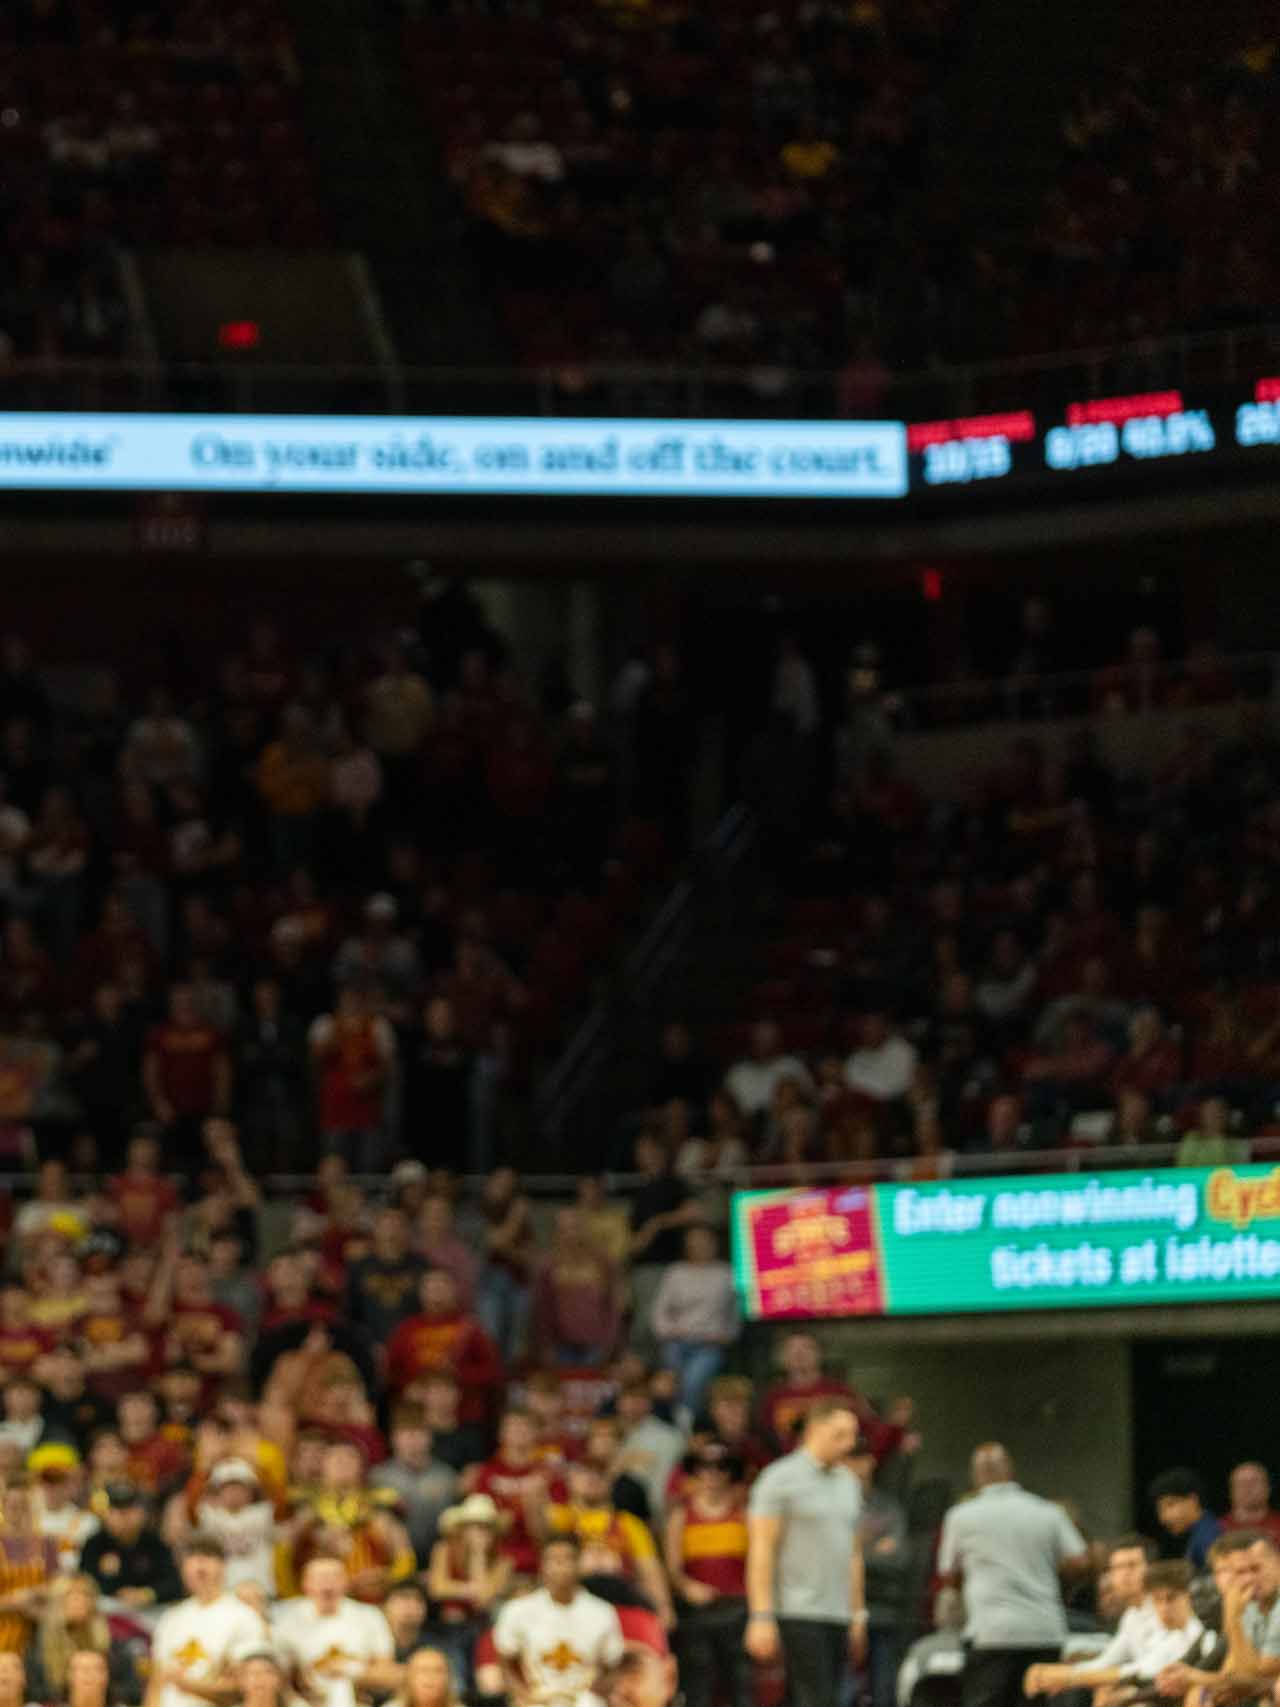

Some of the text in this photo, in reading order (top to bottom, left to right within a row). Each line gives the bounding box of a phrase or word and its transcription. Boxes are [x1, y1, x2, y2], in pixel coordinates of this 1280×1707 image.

[192, 431, 255, 468] On
[262, 439, 358, 487] your
[474, 441, 532, 471] on
[542, 432, 619, 472] and
[628, 432, 687, 473] off
[693, 432, 763, 473] the
[894, 1187, 987, 1236] Enter
[992, 1176, 1198, 1232] nonwinning
[991, 1241, 1113, 1290] tickets
[1121, 1238, 1158, 1285] at
